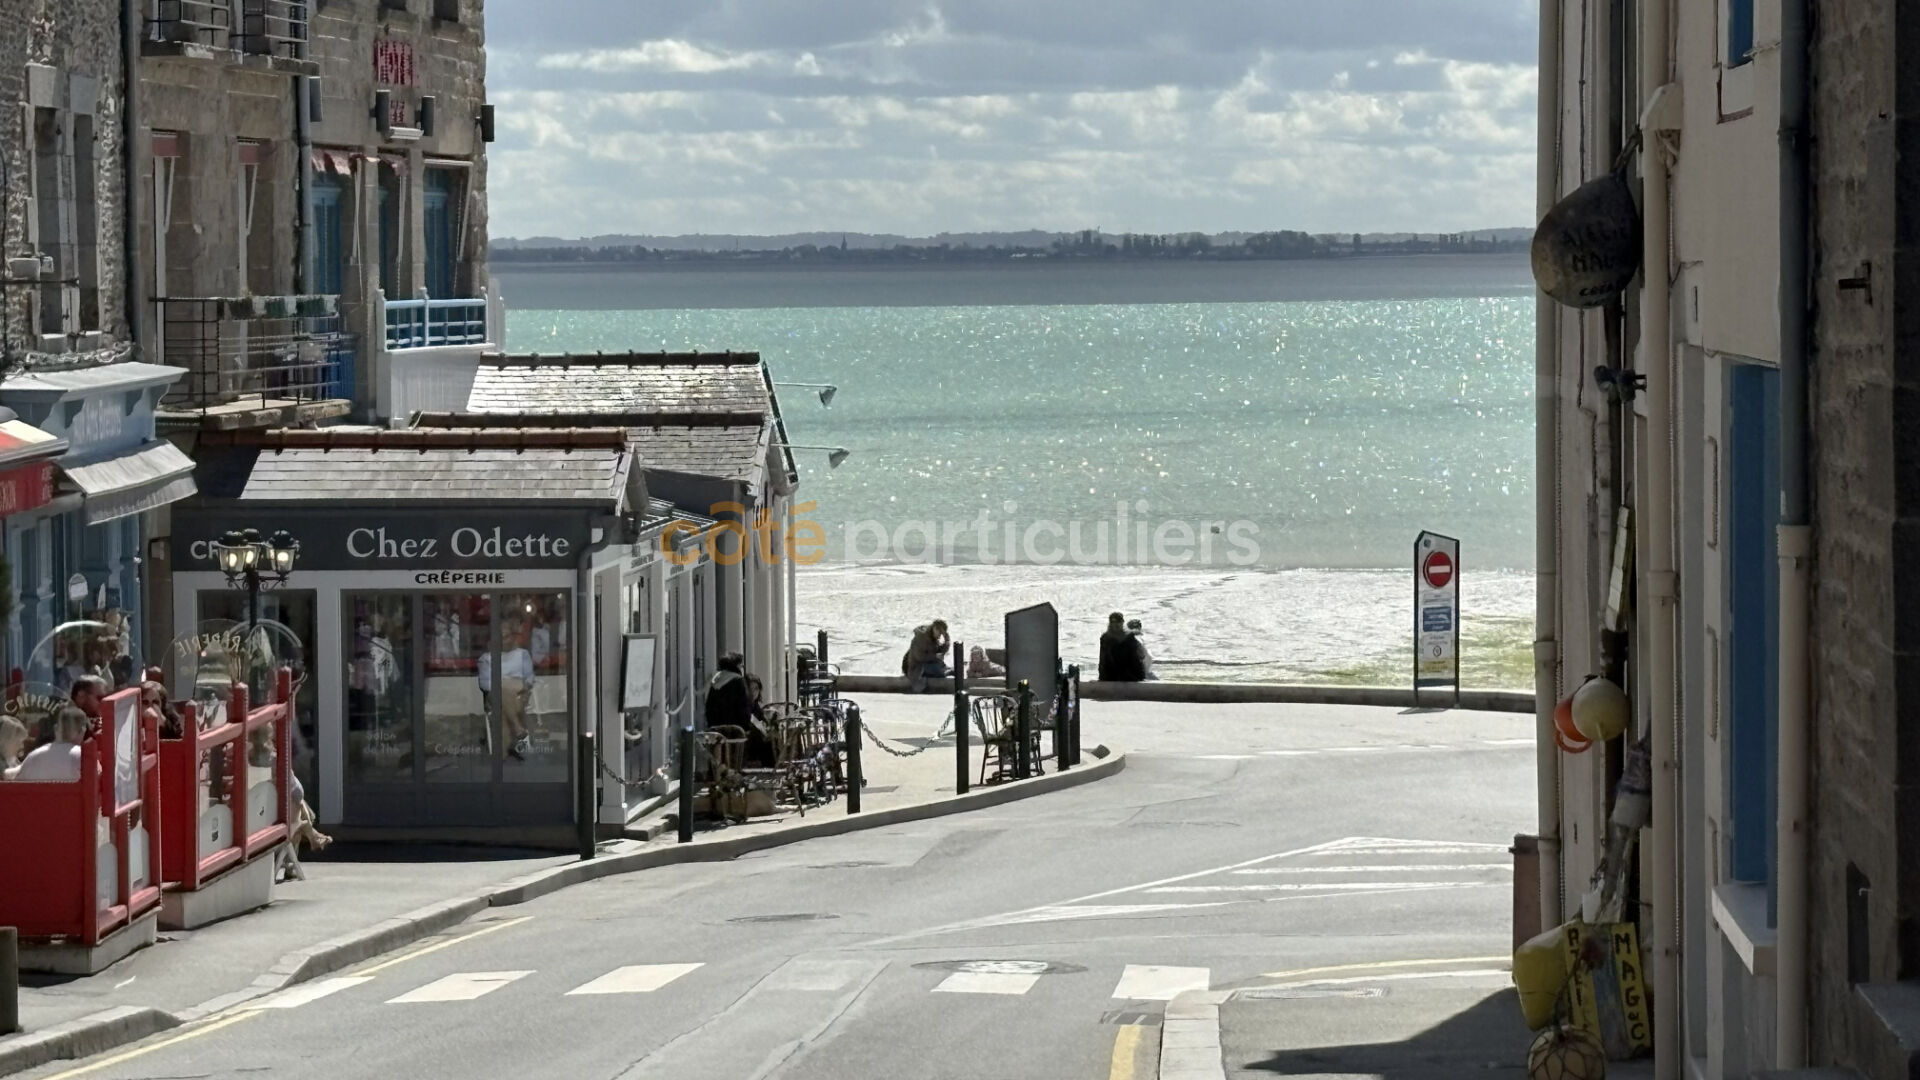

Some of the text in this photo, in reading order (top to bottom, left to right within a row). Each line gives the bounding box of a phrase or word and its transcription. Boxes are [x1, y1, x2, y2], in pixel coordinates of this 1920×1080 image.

[346, 526, 570, 558] Chez Odette
[415, 570, 506, 584] CRÊPERIE
